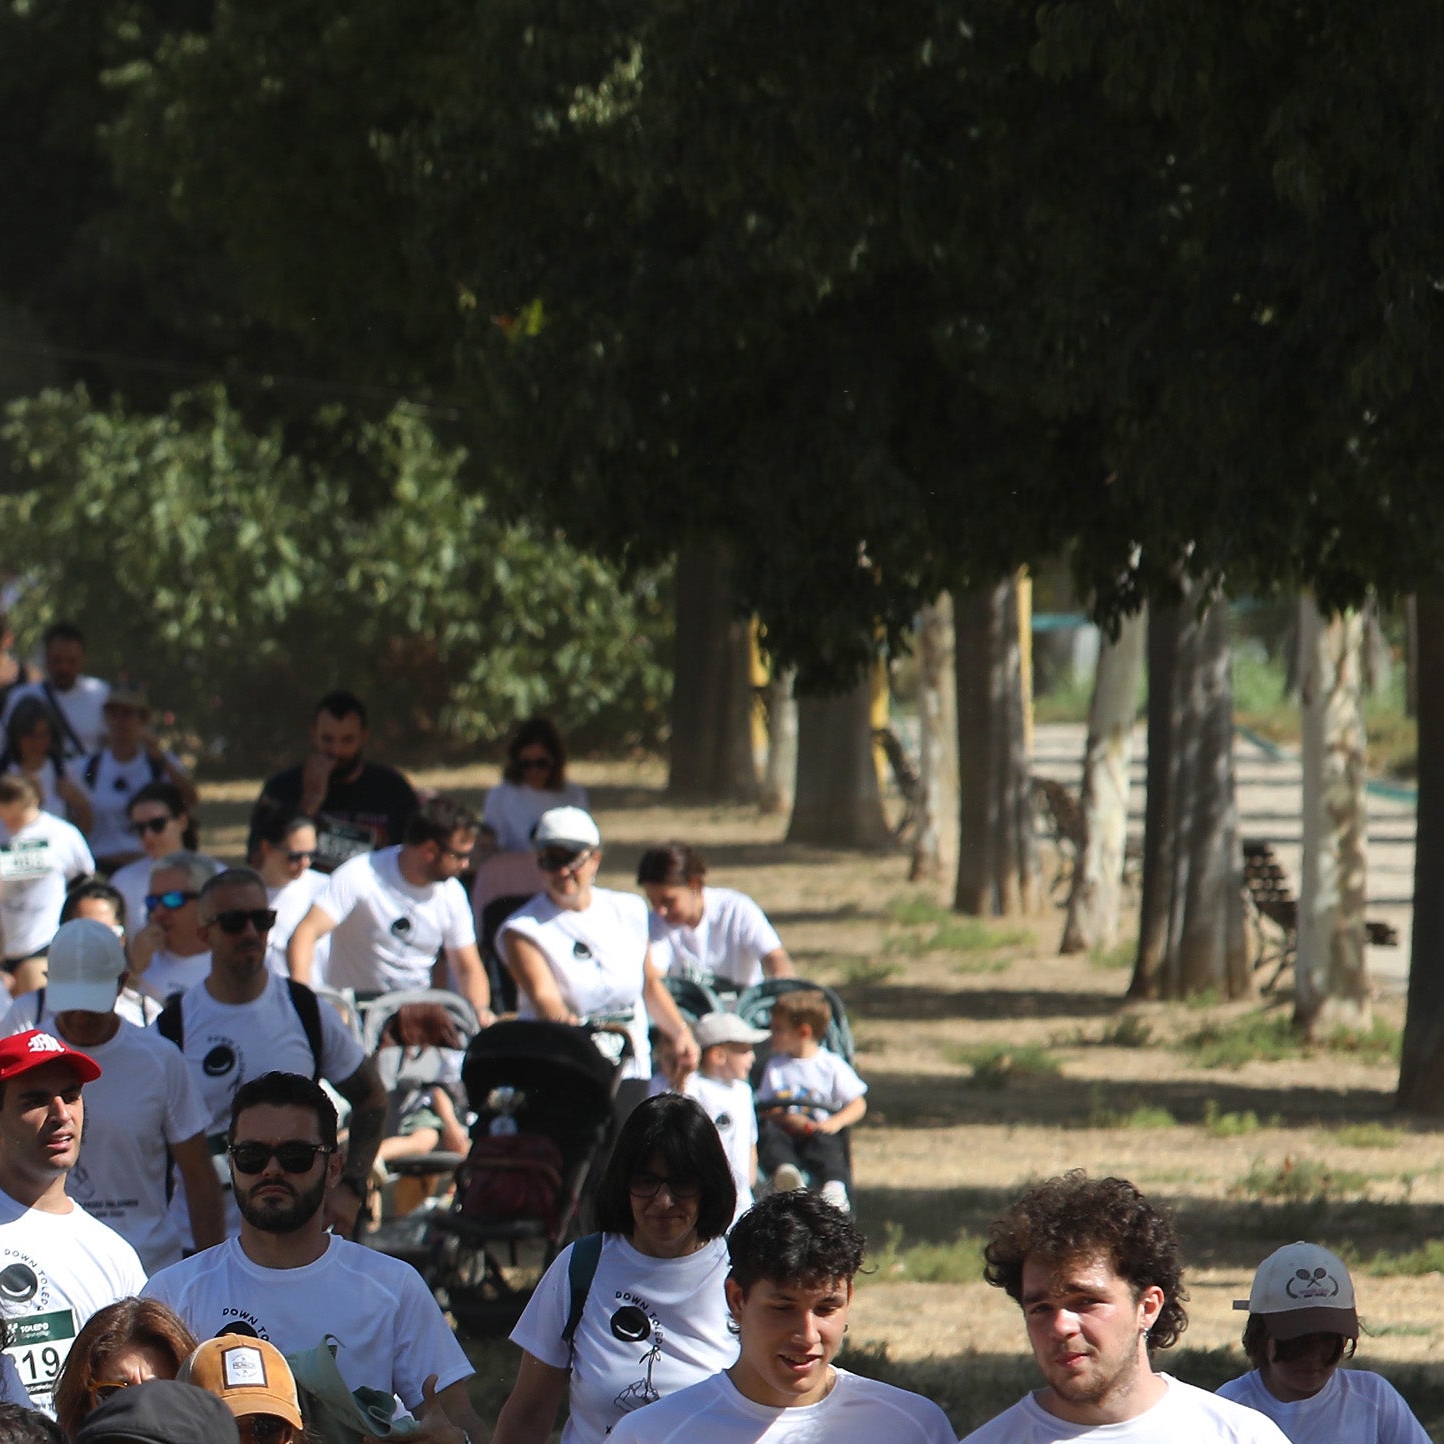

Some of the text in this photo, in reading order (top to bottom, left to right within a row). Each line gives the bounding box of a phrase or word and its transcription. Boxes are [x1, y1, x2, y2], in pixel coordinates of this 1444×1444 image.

[4, 1248, 38, 1268] DOWN
[616, 1291, 650, 1310] DOWN
[222, 1307, 259, 1325] DOWN
[19, 1322, 50, 1333] TOLEDO
